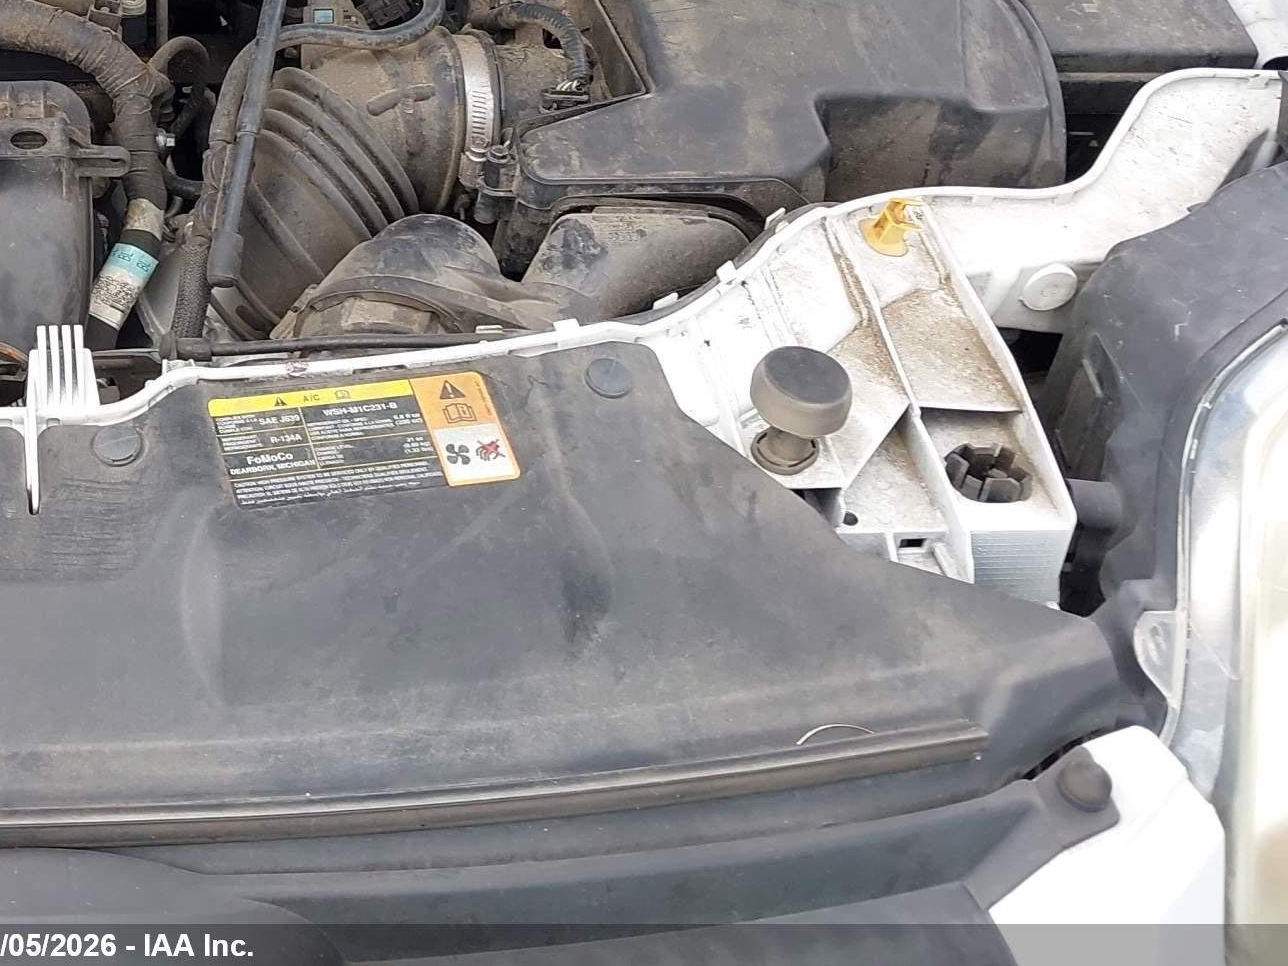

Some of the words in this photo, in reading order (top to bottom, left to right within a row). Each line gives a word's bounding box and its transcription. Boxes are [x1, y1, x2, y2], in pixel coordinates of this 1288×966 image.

[303, 394, 320, 403] A/C
[259, 416, 279, 426] SAE
[270, 433, 303, 443] R-134A
[247, 453, 293, 464] FoMoCo
[229, 465, 276, 476] DEARBORN,
[277, 459, 316, 470] MICHIGAN
